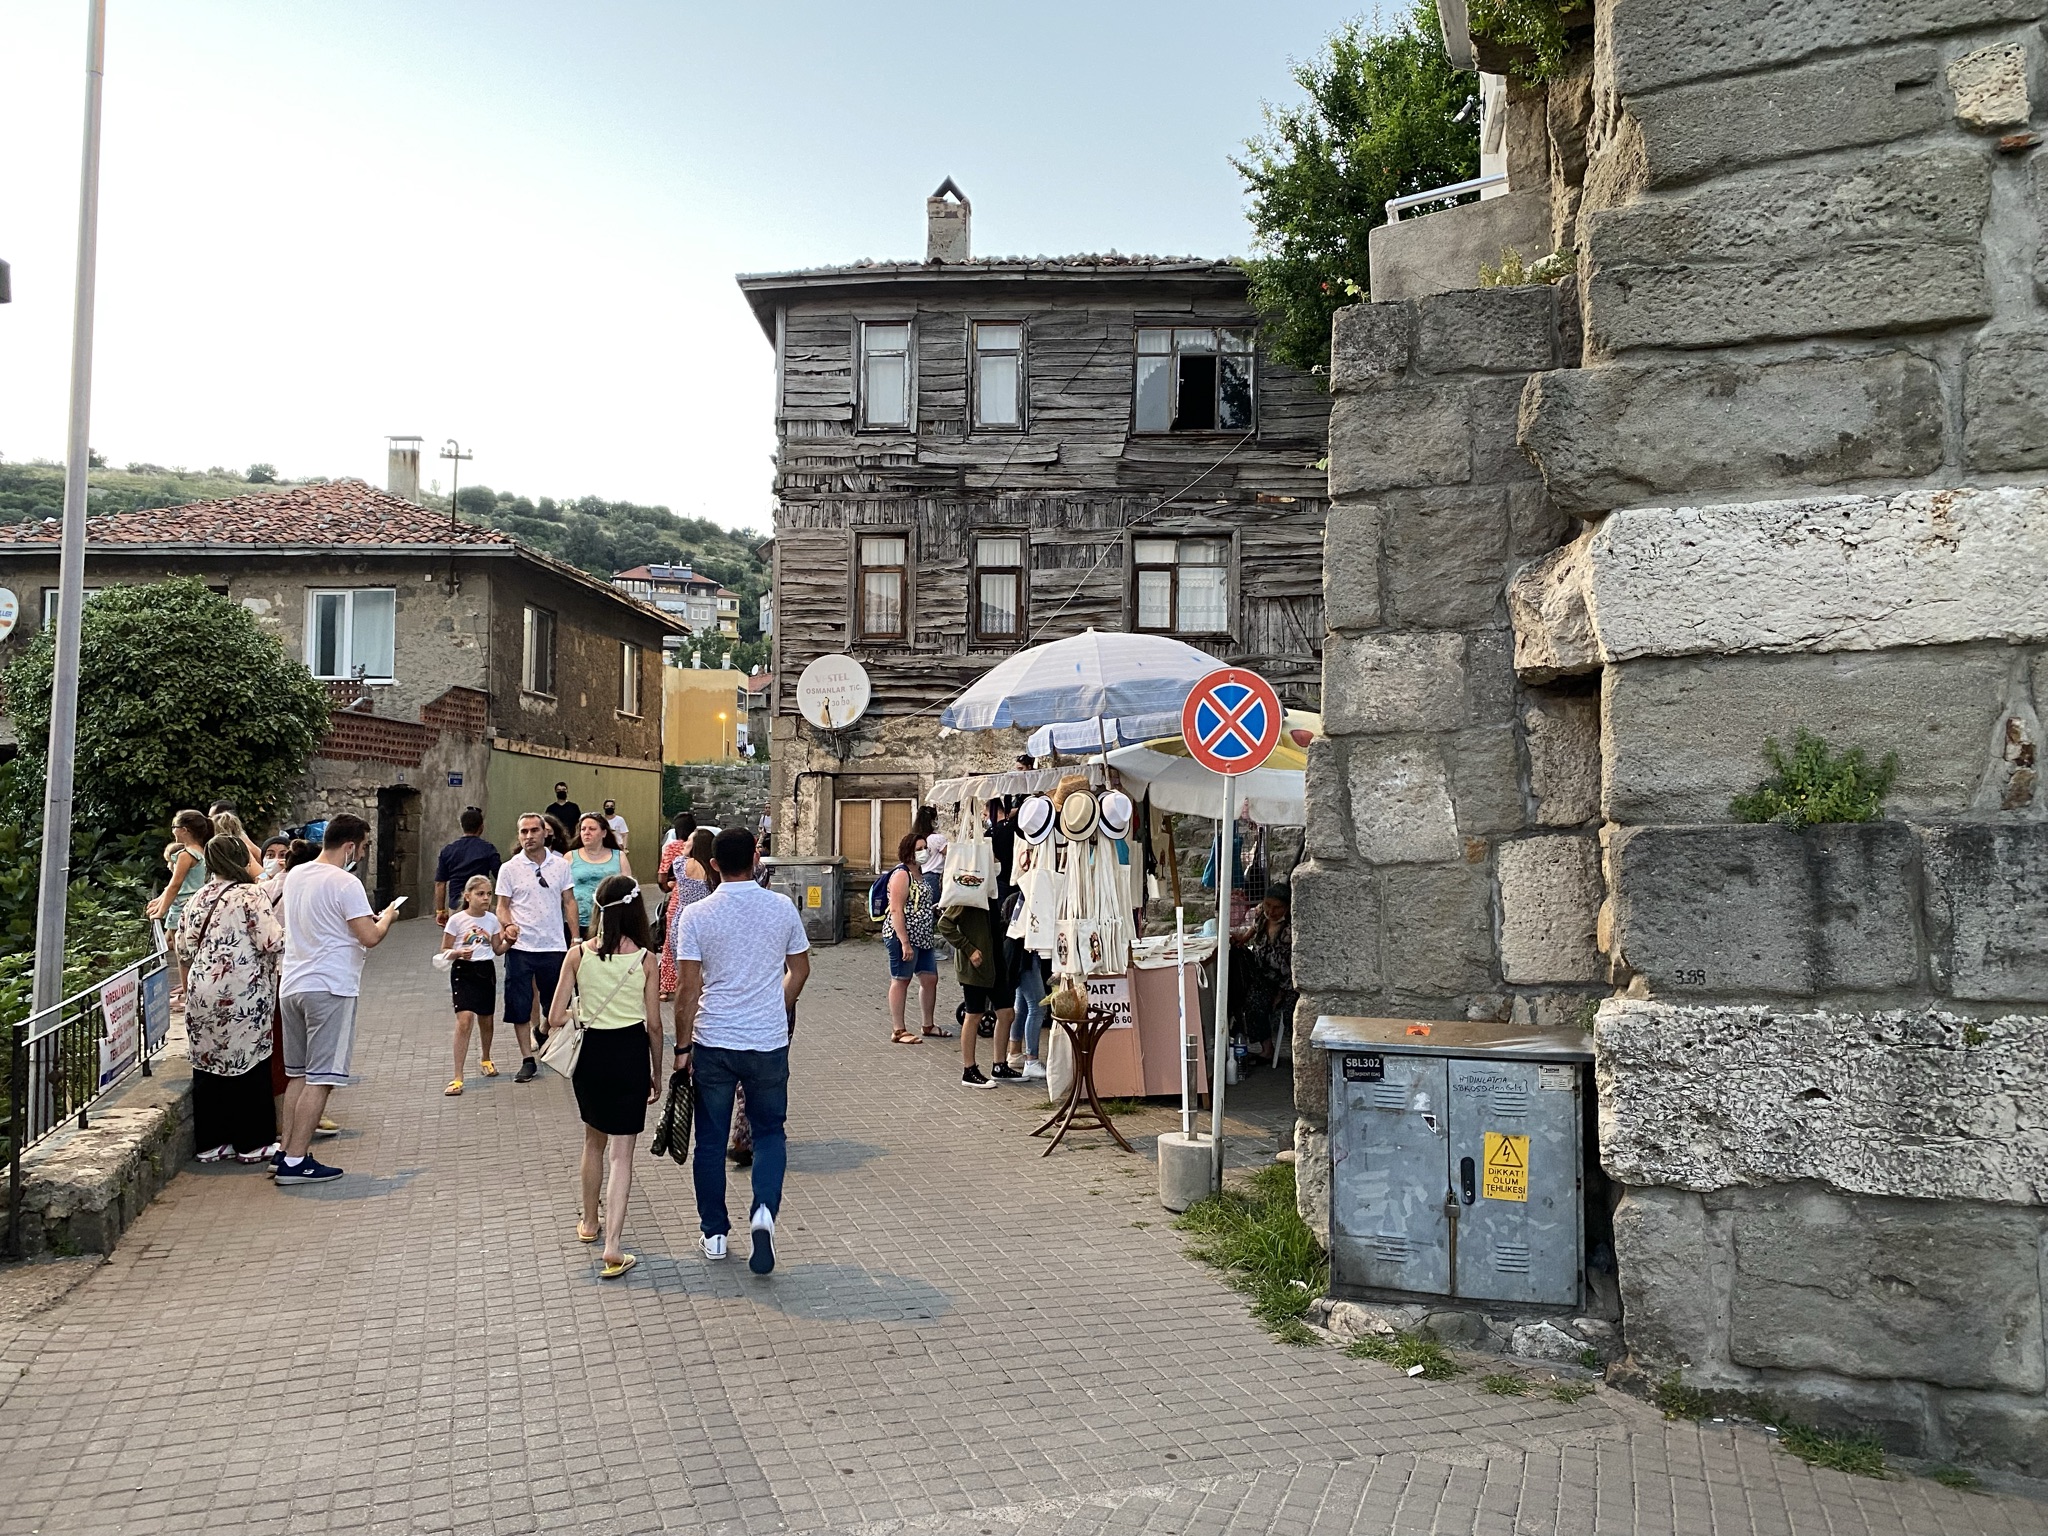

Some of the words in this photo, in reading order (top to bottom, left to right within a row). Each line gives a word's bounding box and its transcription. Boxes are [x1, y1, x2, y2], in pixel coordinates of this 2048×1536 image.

[815, 673, 850, 683] VSTEL
[805, 686, 846, 695] OSMANLAR
[831, 699, 840, 707] 30
[1122, 1016, 1132, 1024] 60
[1346, 1058, 1381, 1068] SBL302
